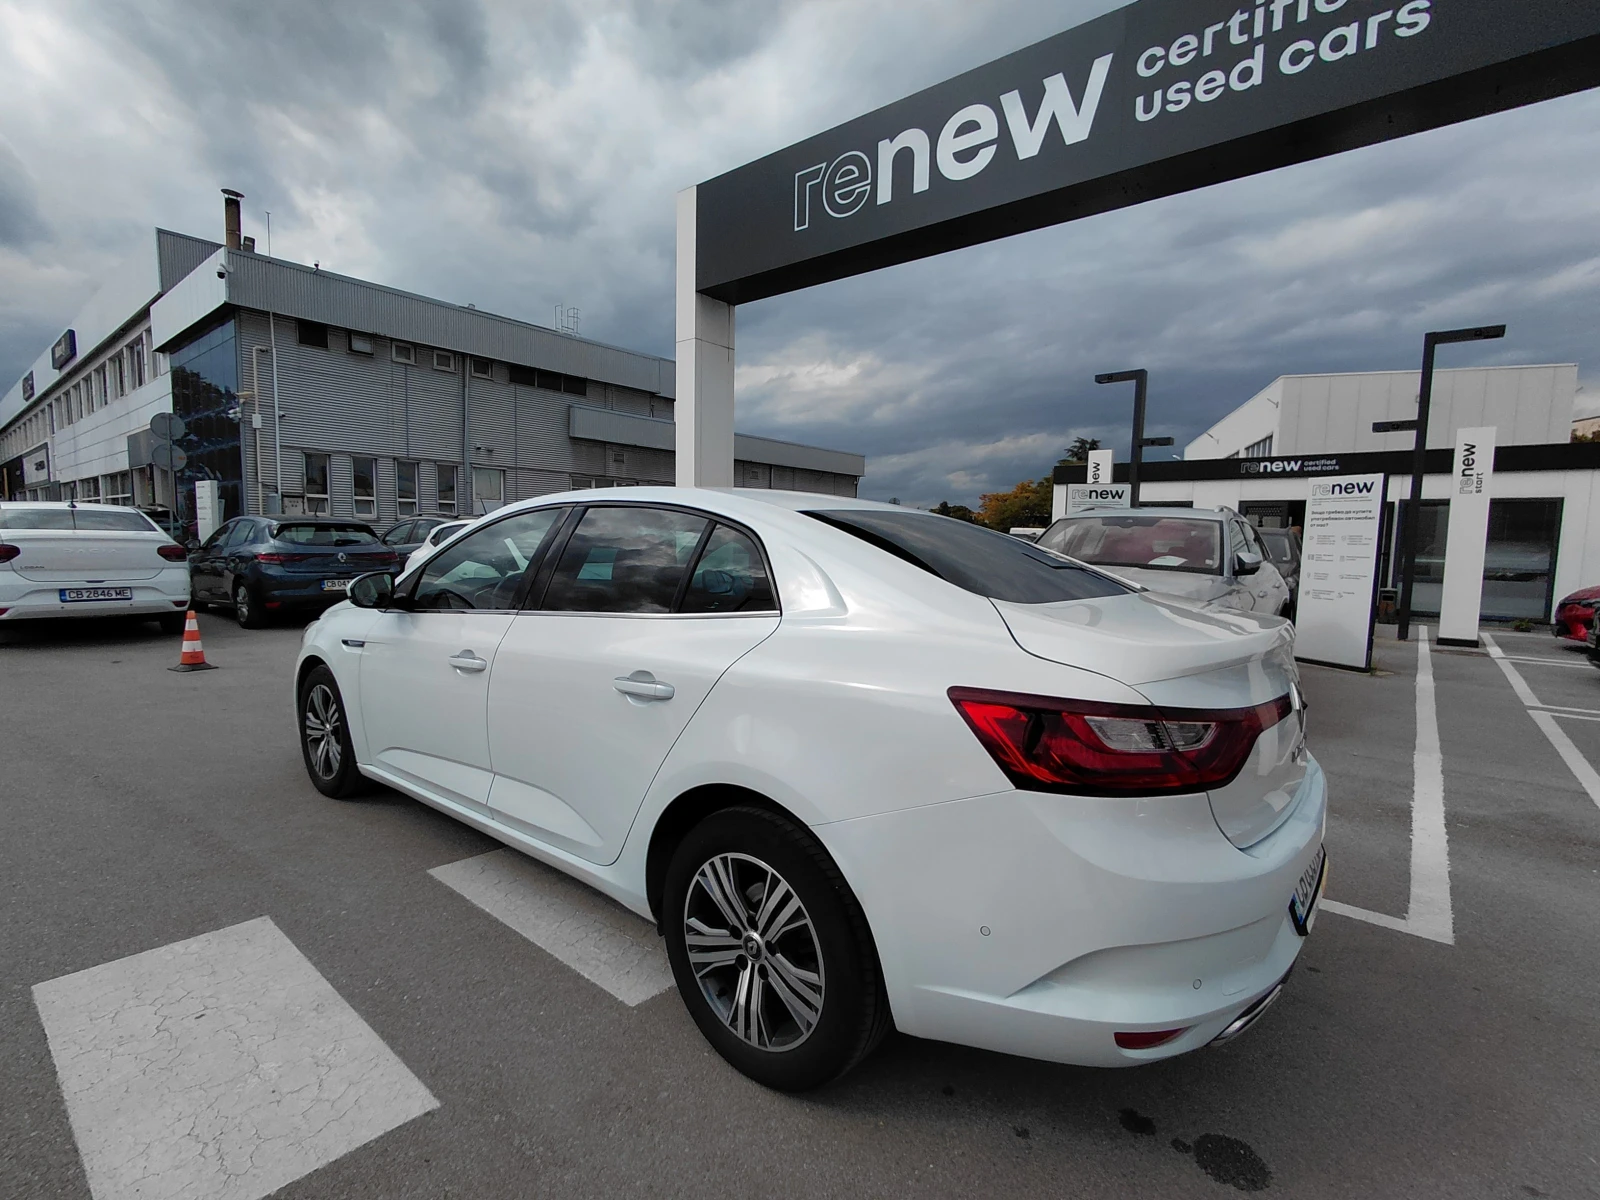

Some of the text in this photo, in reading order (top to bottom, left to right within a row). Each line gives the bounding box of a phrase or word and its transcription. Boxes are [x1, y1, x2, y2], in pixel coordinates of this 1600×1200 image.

[1135, 0, 1431, 122] used cars
[794, 52, 1115, 232] renew
[1241, 460, 1302, 474] renew
[1460, 443, 1476, 494] renew
[1312, 481, 1375, 497] renew
[1475, 472, 1484, 494] start
[1071, 488, 1125, 500] renew
[86, 589, 113, 599] 2846
[115, 589, 130, 598] ME
